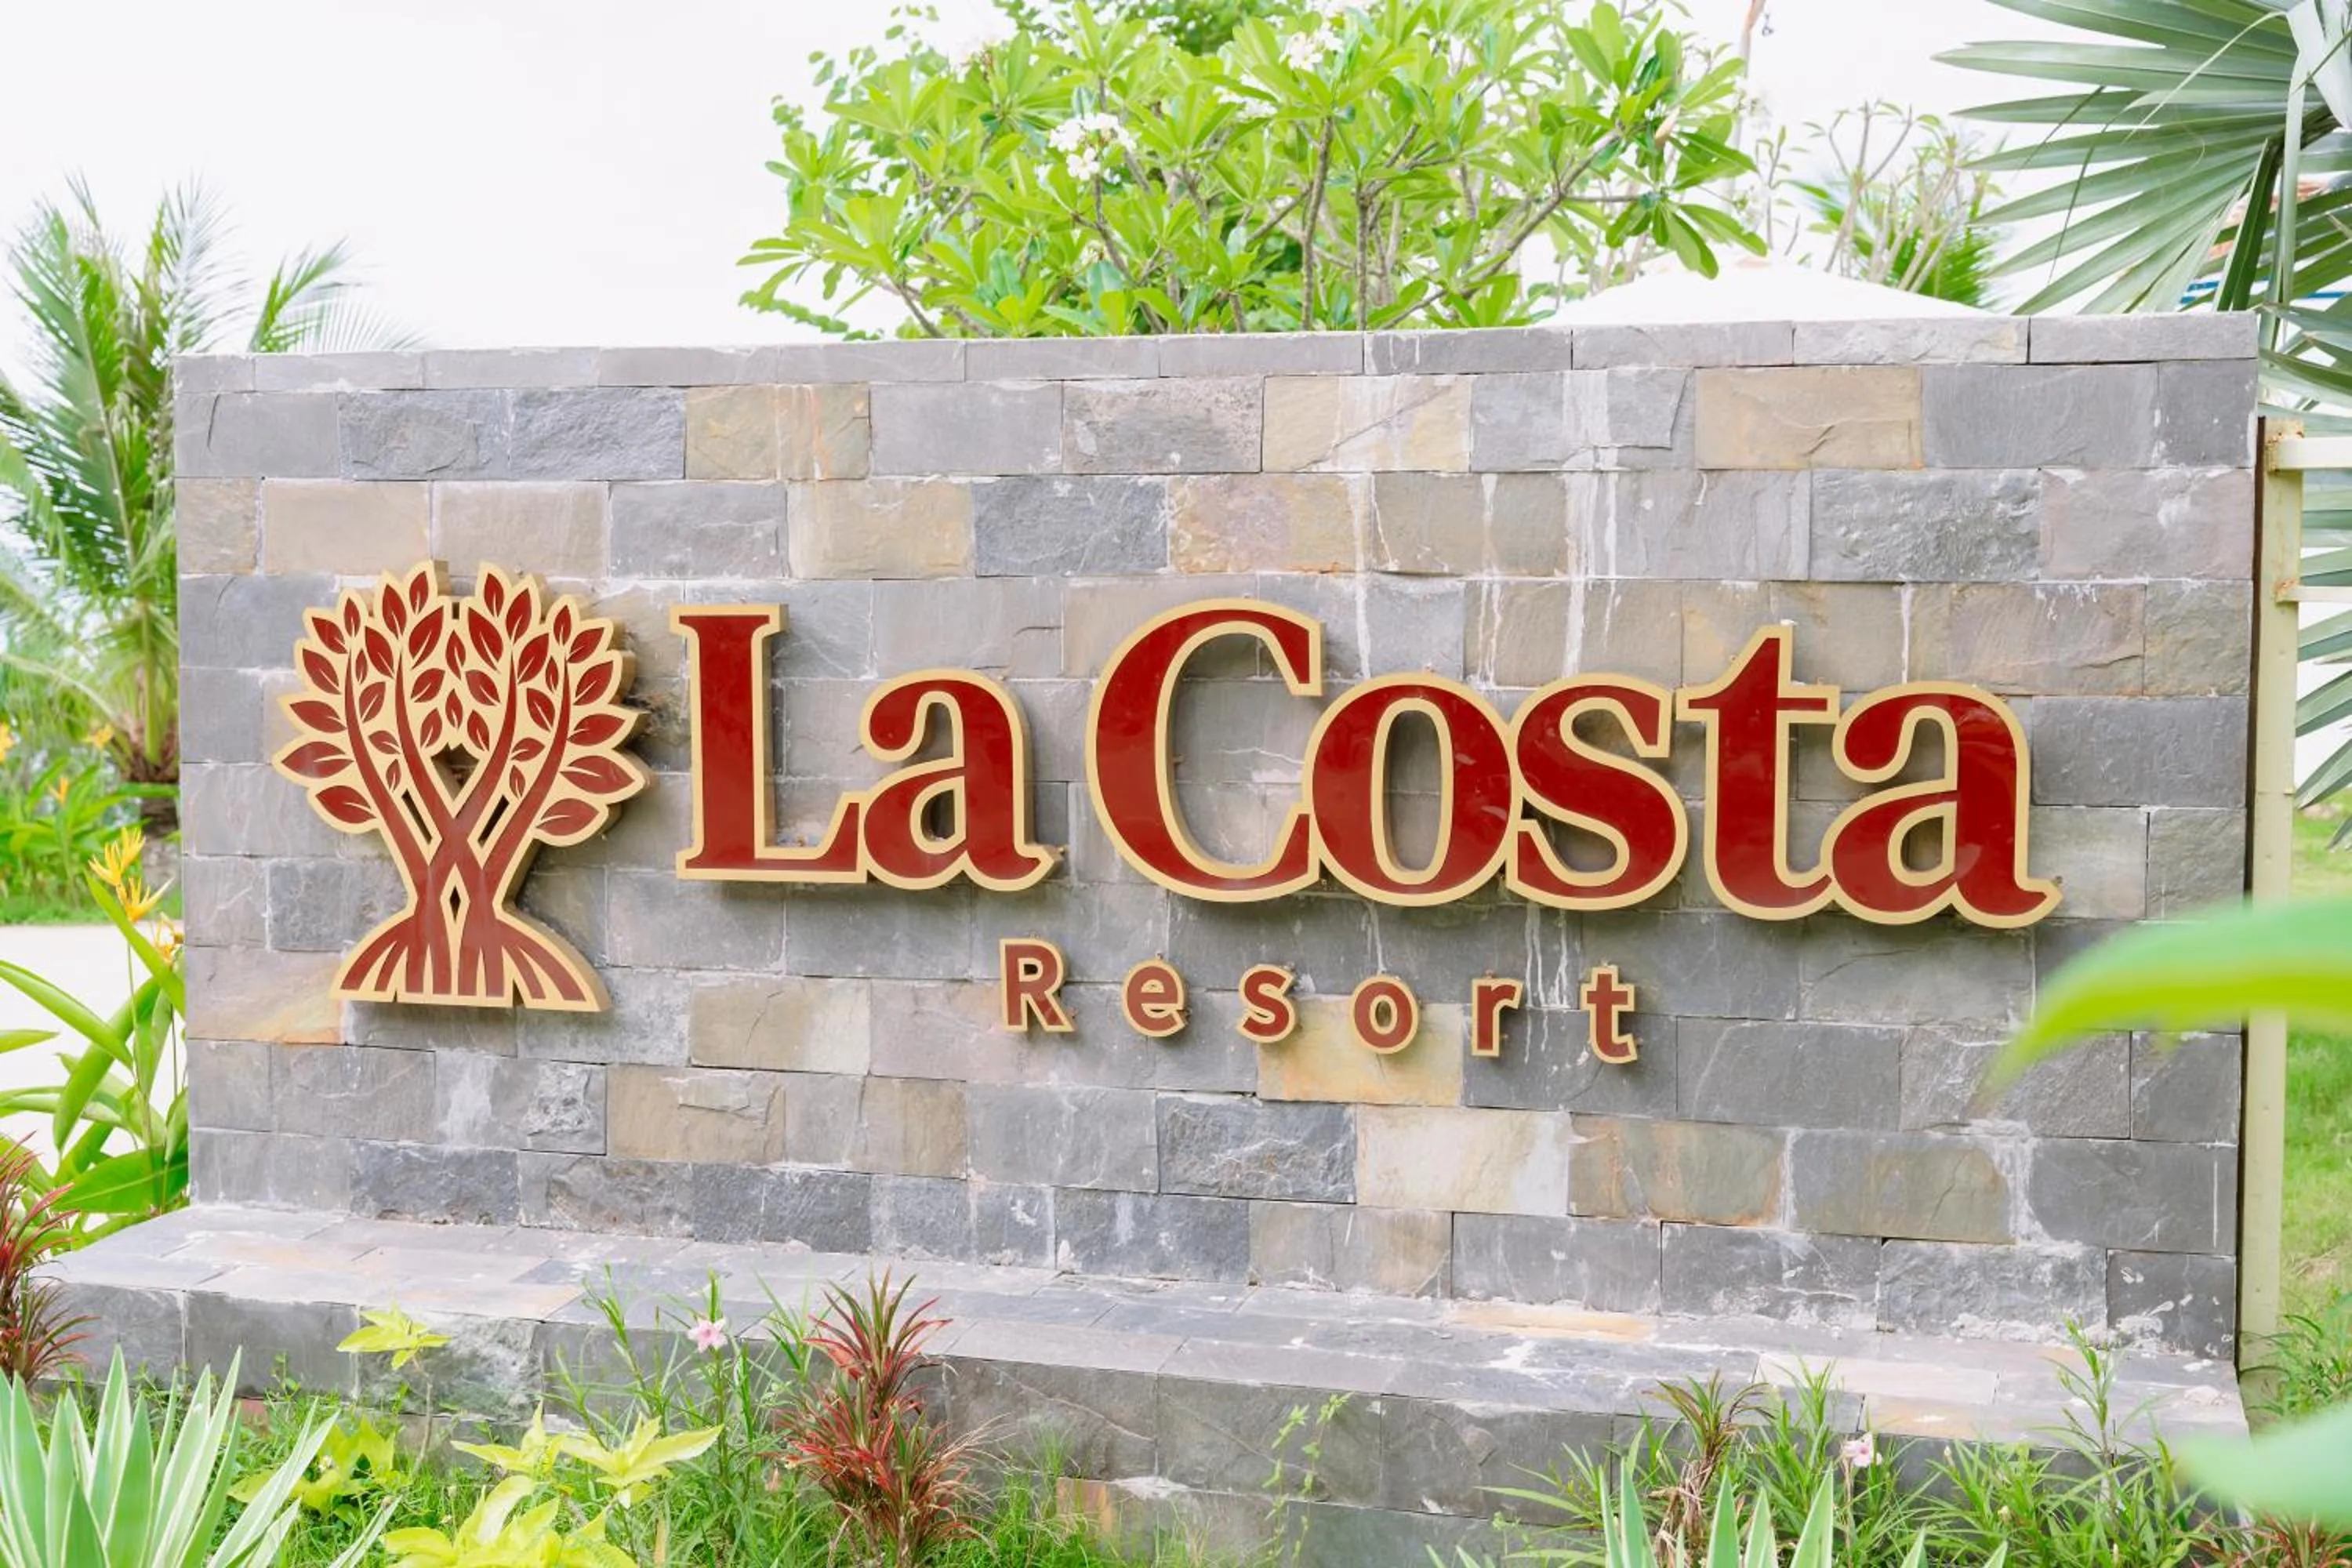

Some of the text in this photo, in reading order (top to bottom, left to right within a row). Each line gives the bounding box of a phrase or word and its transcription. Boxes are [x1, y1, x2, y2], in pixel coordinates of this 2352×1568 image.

[670, 597, 2062, 928] La Costa
[999, 938, 1638, 1065] Resort
